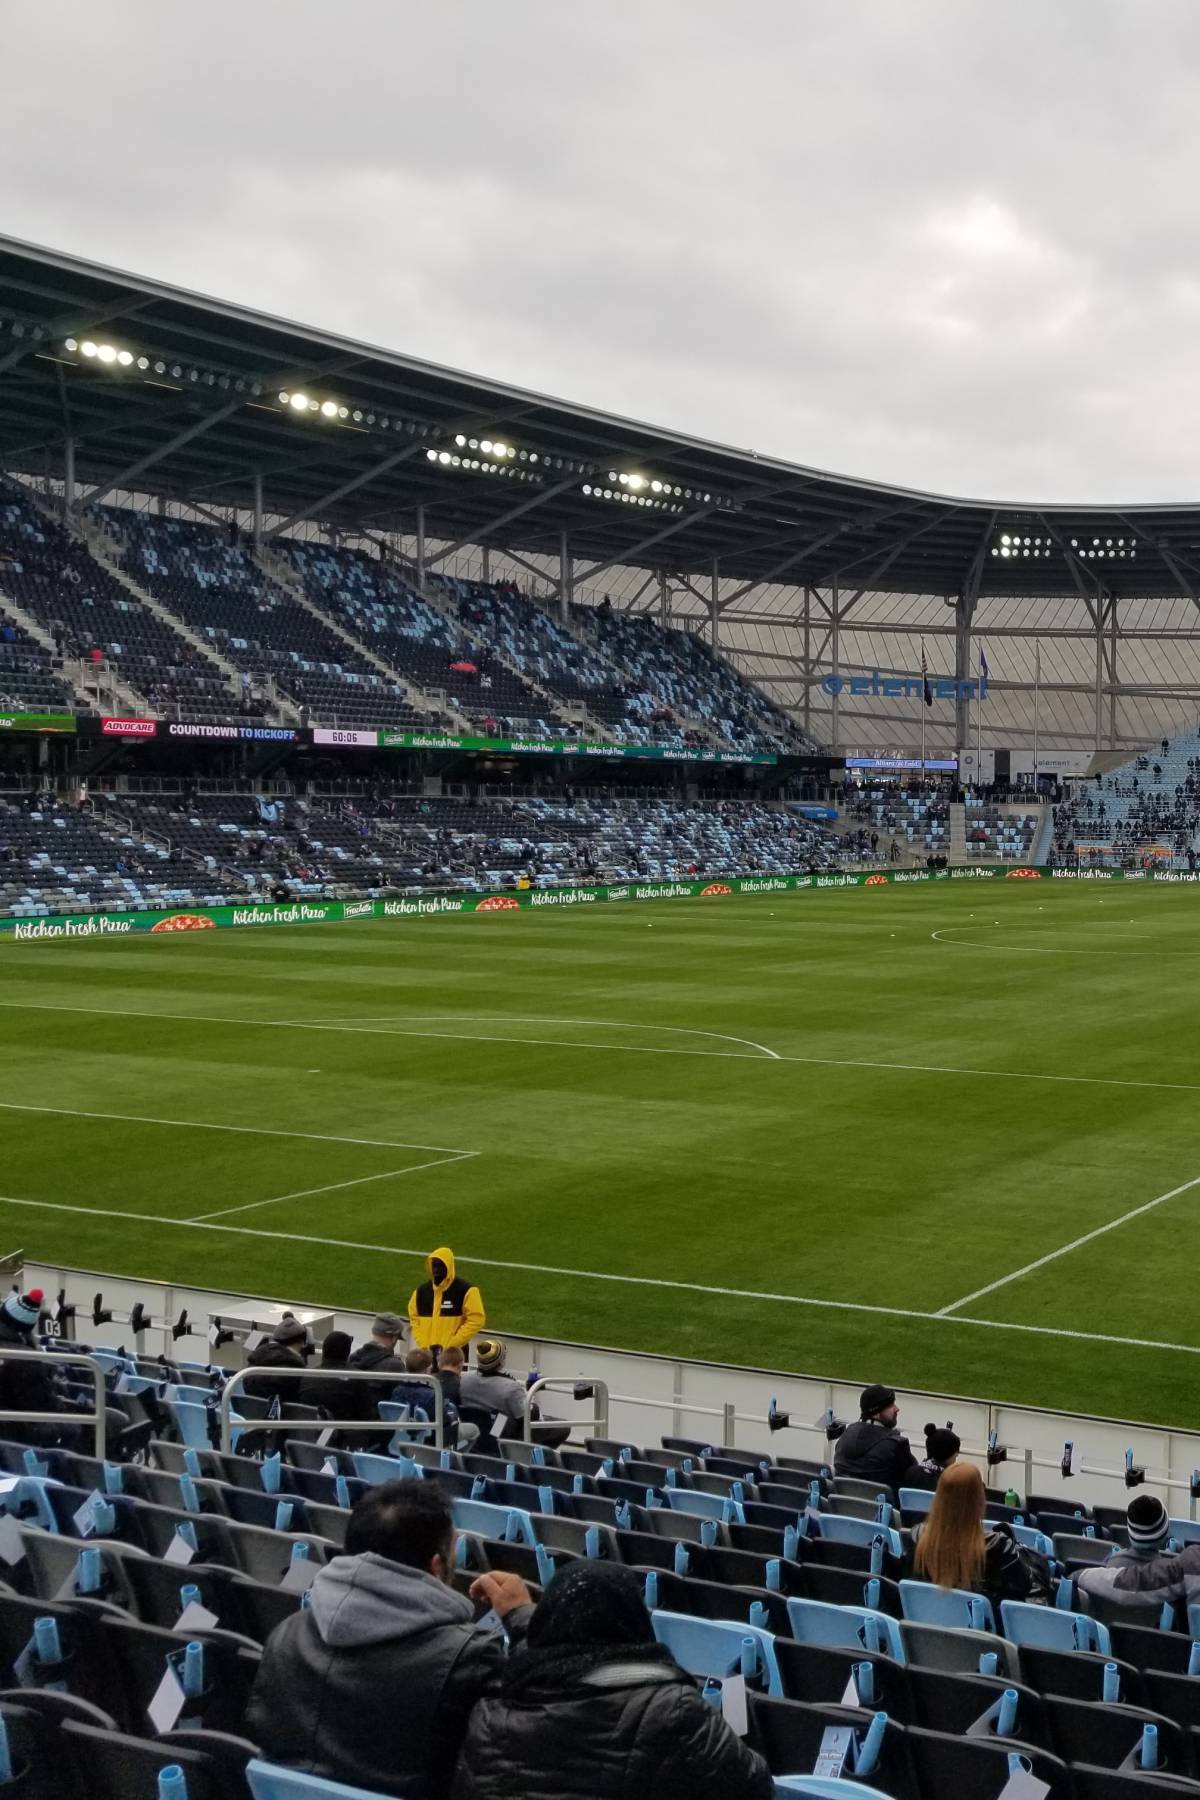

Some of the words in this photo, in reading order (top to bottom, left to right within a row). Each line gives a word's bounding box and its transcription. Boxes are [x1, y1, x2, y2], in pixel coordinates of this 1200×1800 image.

[104, 721, 154, 733] ADVOCARE
[169, 724, 238, 737] COUNTDOWN
[239, 728, 253, 738] TO
[254, 728, 295, 740] KICKOFF
[332, 732, 358, 743] 60:06
[1052, 868, 1076, 878] Kitchen
[1077, 868, 1094, 879] Fresh
[1154, 871, 1179, 881] Kitchen
[1179, 871, 1197, 881] Fresh
[636, 887, 659, 899] Kitchen
[660, 886, 675, 897] Fresh
[740, 881, 760, 891] Kitchen
[760, 880, 773, 891] Fresh
[384, 900, 417, 914] Kitchen
[418, 898, 440, 913] Fresh
[441, 897, 462, 910] Pizza
[531, 892, 559, 906] Kitchen
[559, 891, 578, 904] Fresh
[578, 891, 595, 902] Pizza
[233, 908, 272, 925] Kitchen
[273, 906, 299, 923] Fresh
[301, 905, 326, 920] Pizza
[15, 922, 63, 940] Kitchen
[65, 917, 97, 936] Fresh
[99, 916, 130, 933] Pizza
[45, 1319, 61, 1337] 03
